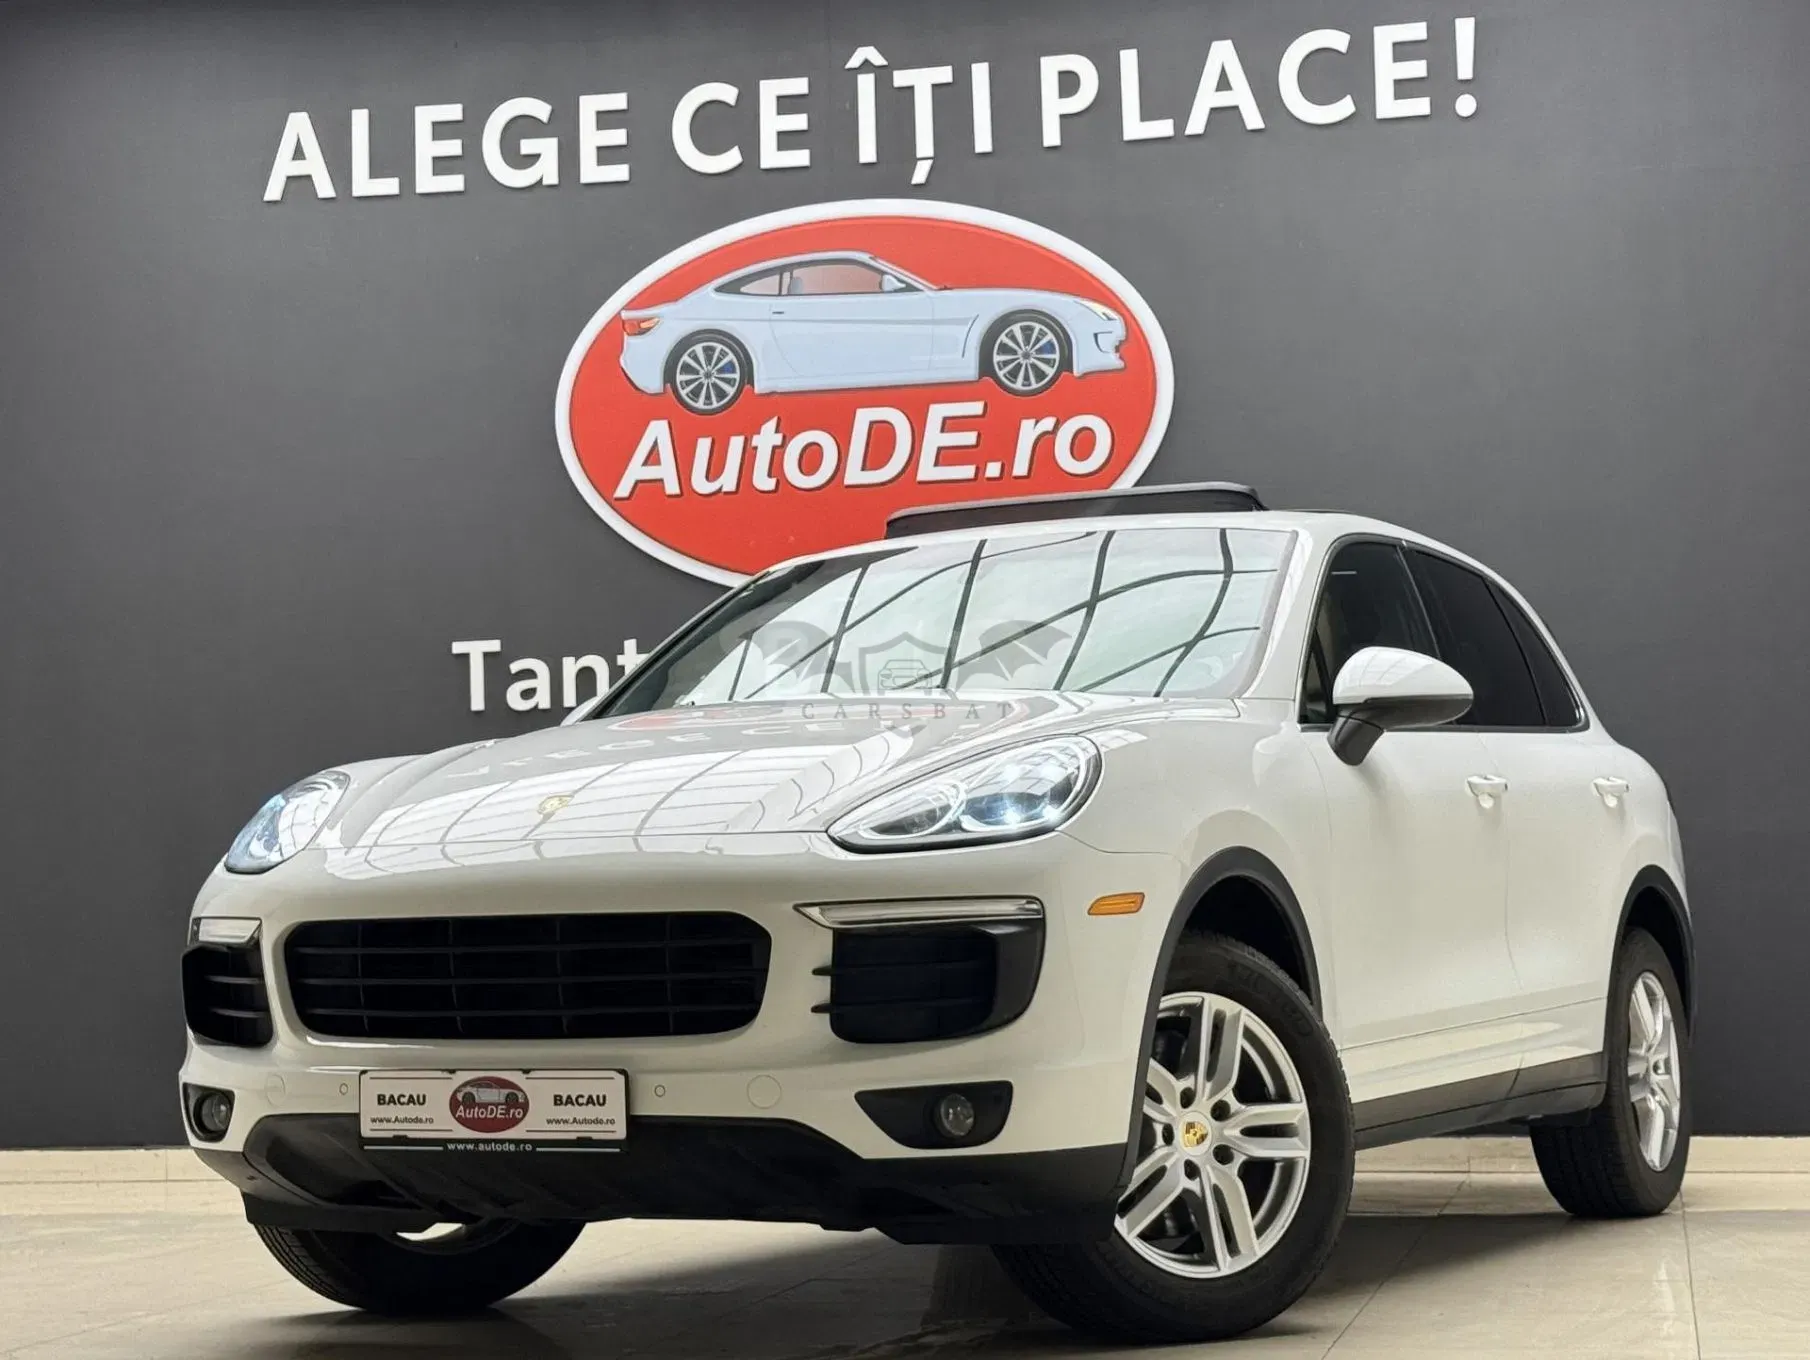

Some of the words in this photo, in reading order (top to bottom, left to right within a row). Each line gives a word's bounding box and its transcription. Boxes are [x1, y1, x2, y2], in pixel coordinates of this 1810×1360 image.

[263, 92, 631, 202] ALEGE
[671, 76, 811, 174] CE
[1039, 16, 1478, 148] PLACE!
[613, 400, 1114, 500] AutoDE.ro
[377, 1093, 427, 1106] BACAU
[553, 1094, 607, 1107] BACAU
[455, 1104, 524, 1119] AutoDE.ro
[446, 1141, 533, 1152] www.autode.ro
